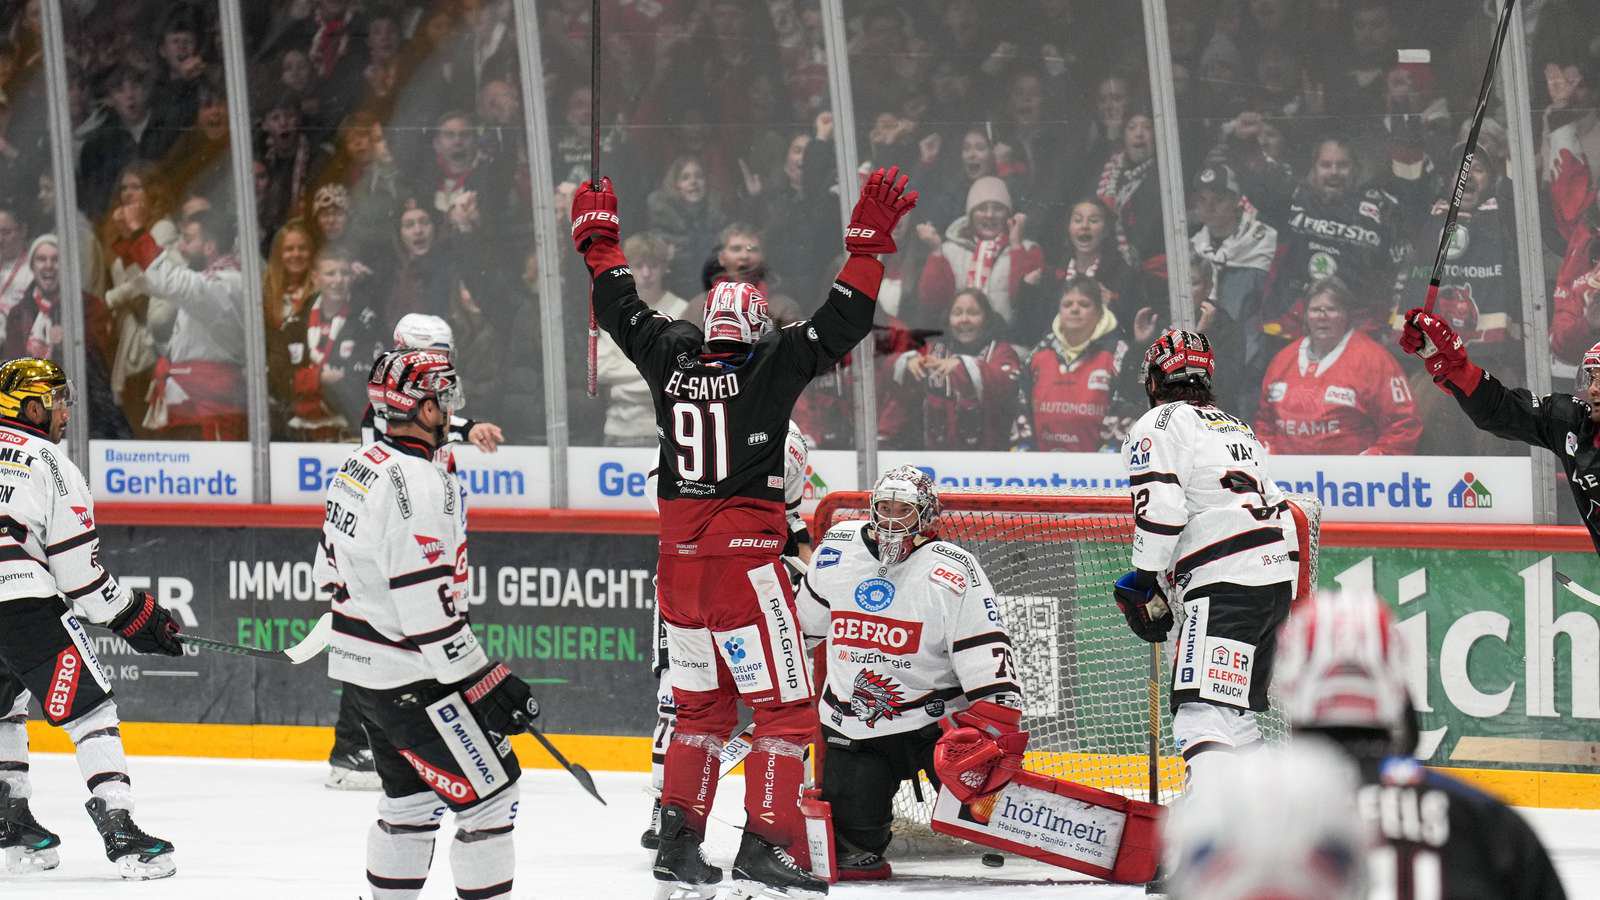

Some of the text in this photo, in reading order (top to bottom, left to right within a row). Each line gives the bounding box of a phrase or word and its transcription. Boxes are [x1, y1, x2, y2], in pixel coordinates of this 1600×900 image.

[664, 370, 739, 400] EL-SAYED
[105, 449, 190, 467] Bauzentrum
[672, 402, 728, 482] 91
[106, 469, 238, 495] Gerhardt
[497, 567, 655, 610] GEDACHT.
[769, 598, 798, 689] Rent.Group
[831, 616, 909, 649] GEFRO
[1185, 604, 1199, 664] MULTIVAC
[49, 654, 77, 717] GEFRO
[121, 665, 139, 681] KG
[1207, 670, 1248, 687] ELEKTRO
[1212, 684, 1243, 698] RAUCH
[452, 724, 495, 785] MULTIVAC
[1002, 797, 1106, 845] höflmeir
[997, 822, 1031, 839] Heizung
[1075, 844, 1102, 858] Service
